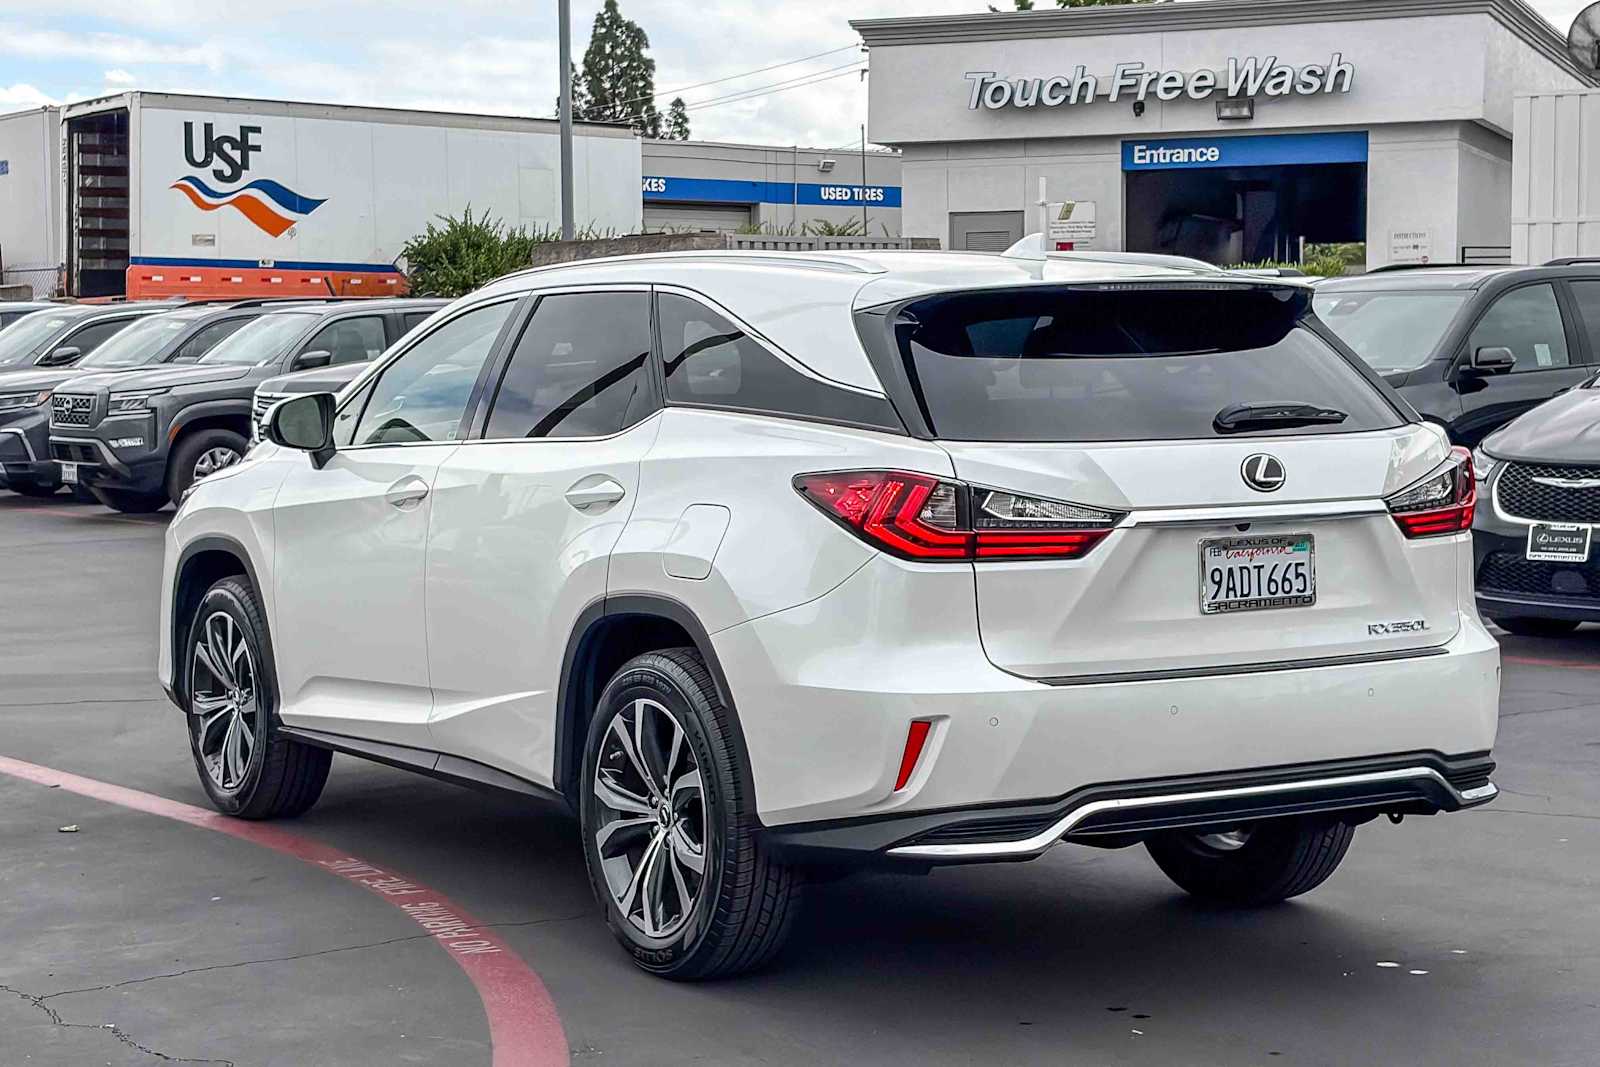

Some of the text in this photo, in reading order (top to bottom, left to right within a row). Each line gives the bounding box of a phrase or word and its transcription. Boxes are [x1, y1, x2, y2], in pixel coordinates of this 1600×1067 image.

[965, 52, 1356, 111] Touch Free Wash
[183, 121, 262, 184] USF
[1133, 145, 1220, 165] Entrance
[820, 185, 884, 201] USED TIRES
[1229, 538, 1268, 547] LEXUS
[1210, 562, 1308, 600] 9ADT665
[1207, 595, 1313, 612] SACRAMENTO
[400, 902, 478, 939] PARKING
[449, 940, 502, 954] NO
